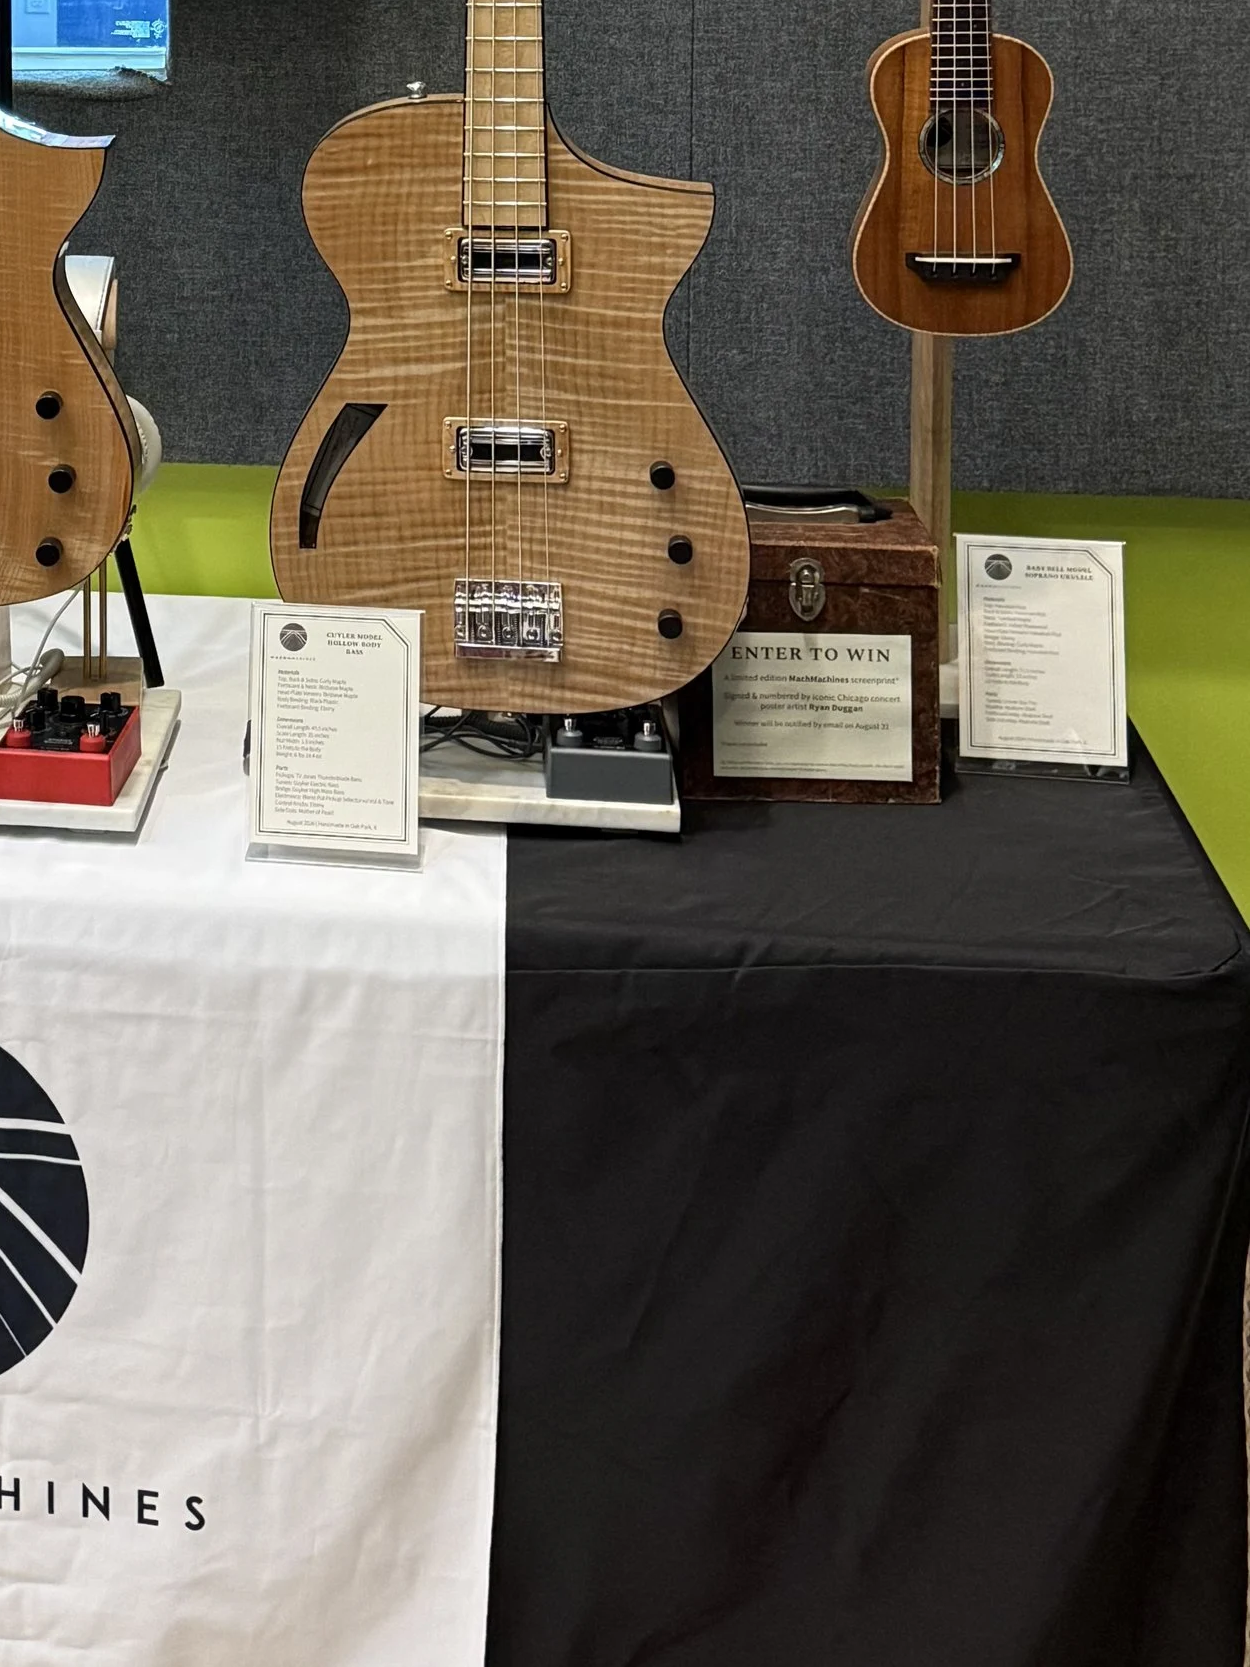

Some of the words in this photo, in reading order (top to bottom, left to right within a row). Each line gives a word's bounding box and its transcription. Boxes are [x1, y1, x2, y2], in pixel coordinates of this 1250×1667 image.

[730, 646, 802, 661] ENTER
[809, 647, 839, 662] TO
[847, 648, 891, 663] WIN
[789, 675, 849, 683] MachMachines
[759, 692, 799, 700] numbered
[801, 694, 810, 702] by
[837, 694, 869, 703] Chicago
[760, 703, 785, 711] poster
[809, 704, 830, 712] Ryan
[832, 704, 863, 714] Duggan
[855, 723, 879, 731] August
